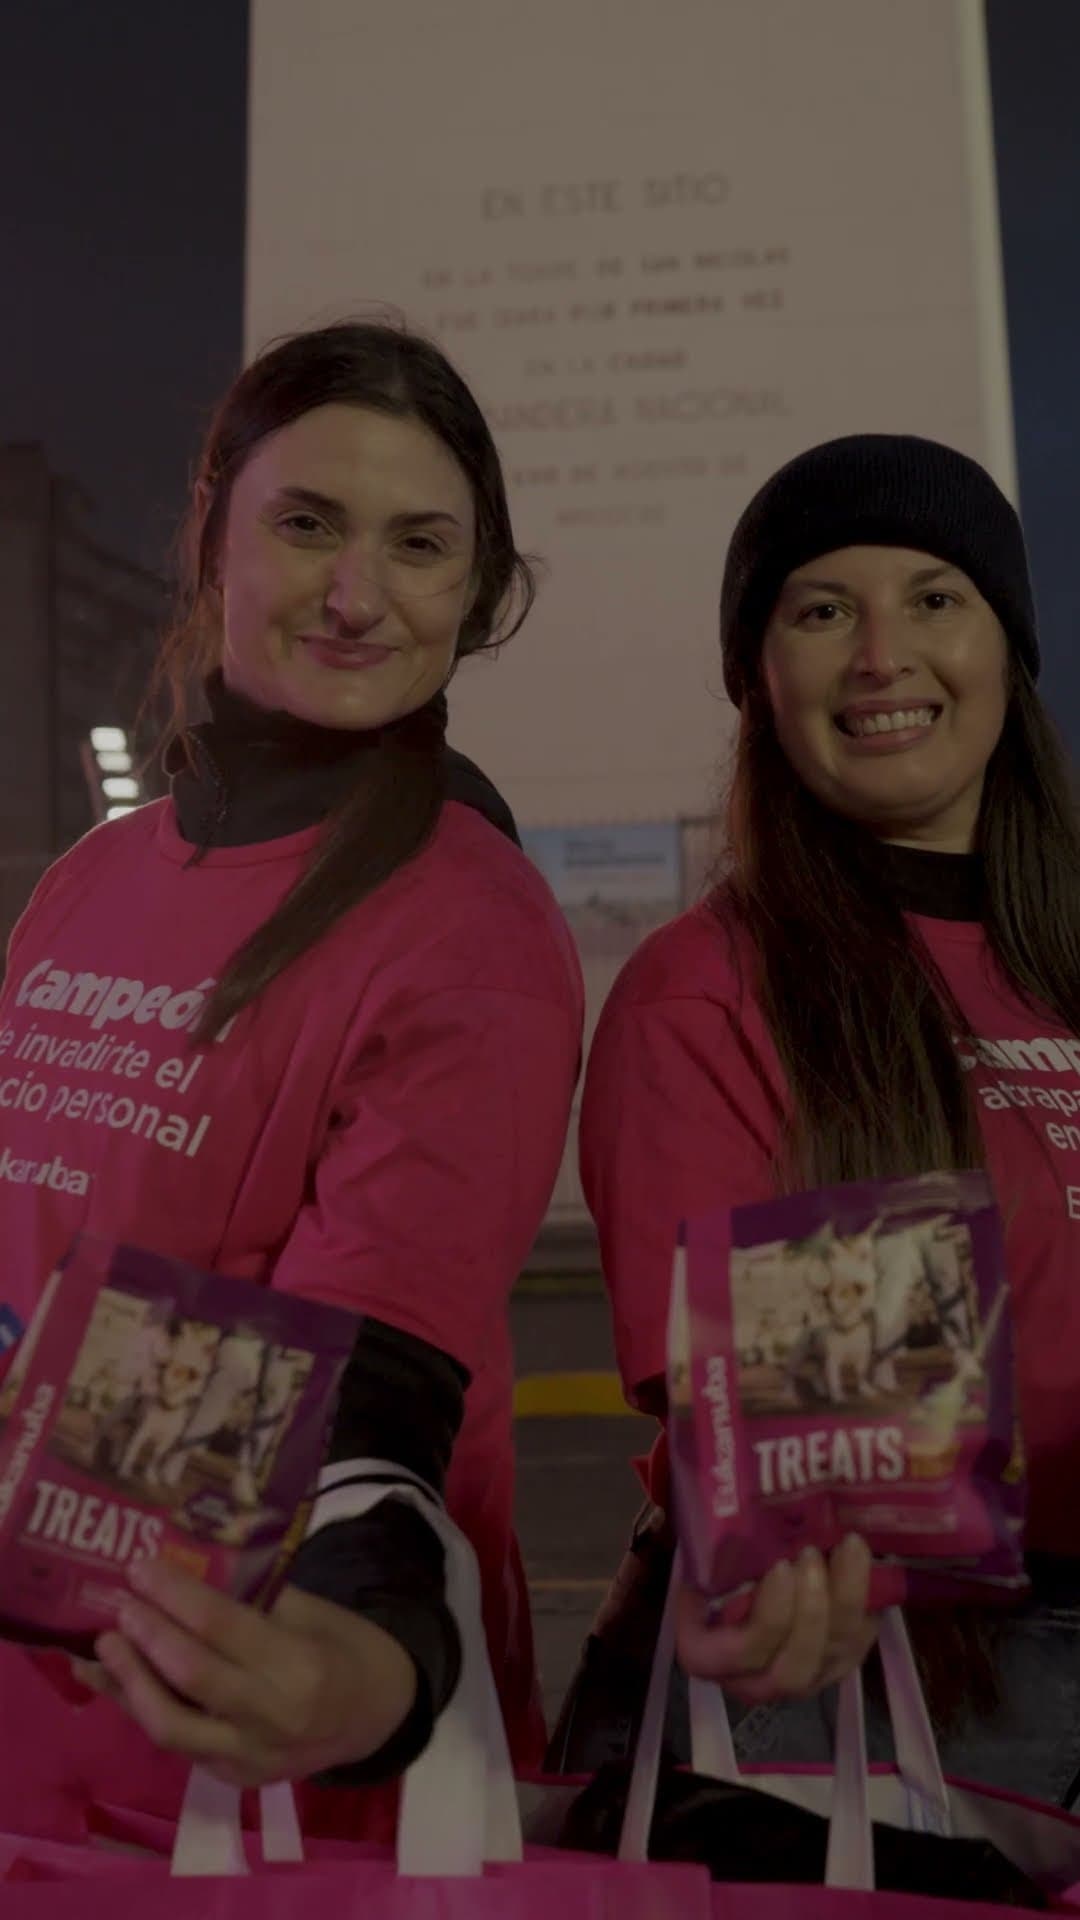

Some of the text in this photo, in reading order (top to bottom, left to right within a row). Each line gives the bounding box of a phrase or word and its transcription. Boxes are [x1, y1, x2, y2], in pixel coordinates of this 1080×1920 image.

[540, 180, 622, 216] ESTE
[643, 171, 731, 208] SITIO
[0, 1020, 204, 1094] e invadirte el
[0, 1070, 212, 1158] cio personal
[752, 1425, 904, 1496] TREATS
[24, 1479, 165, 1562] TREATS
